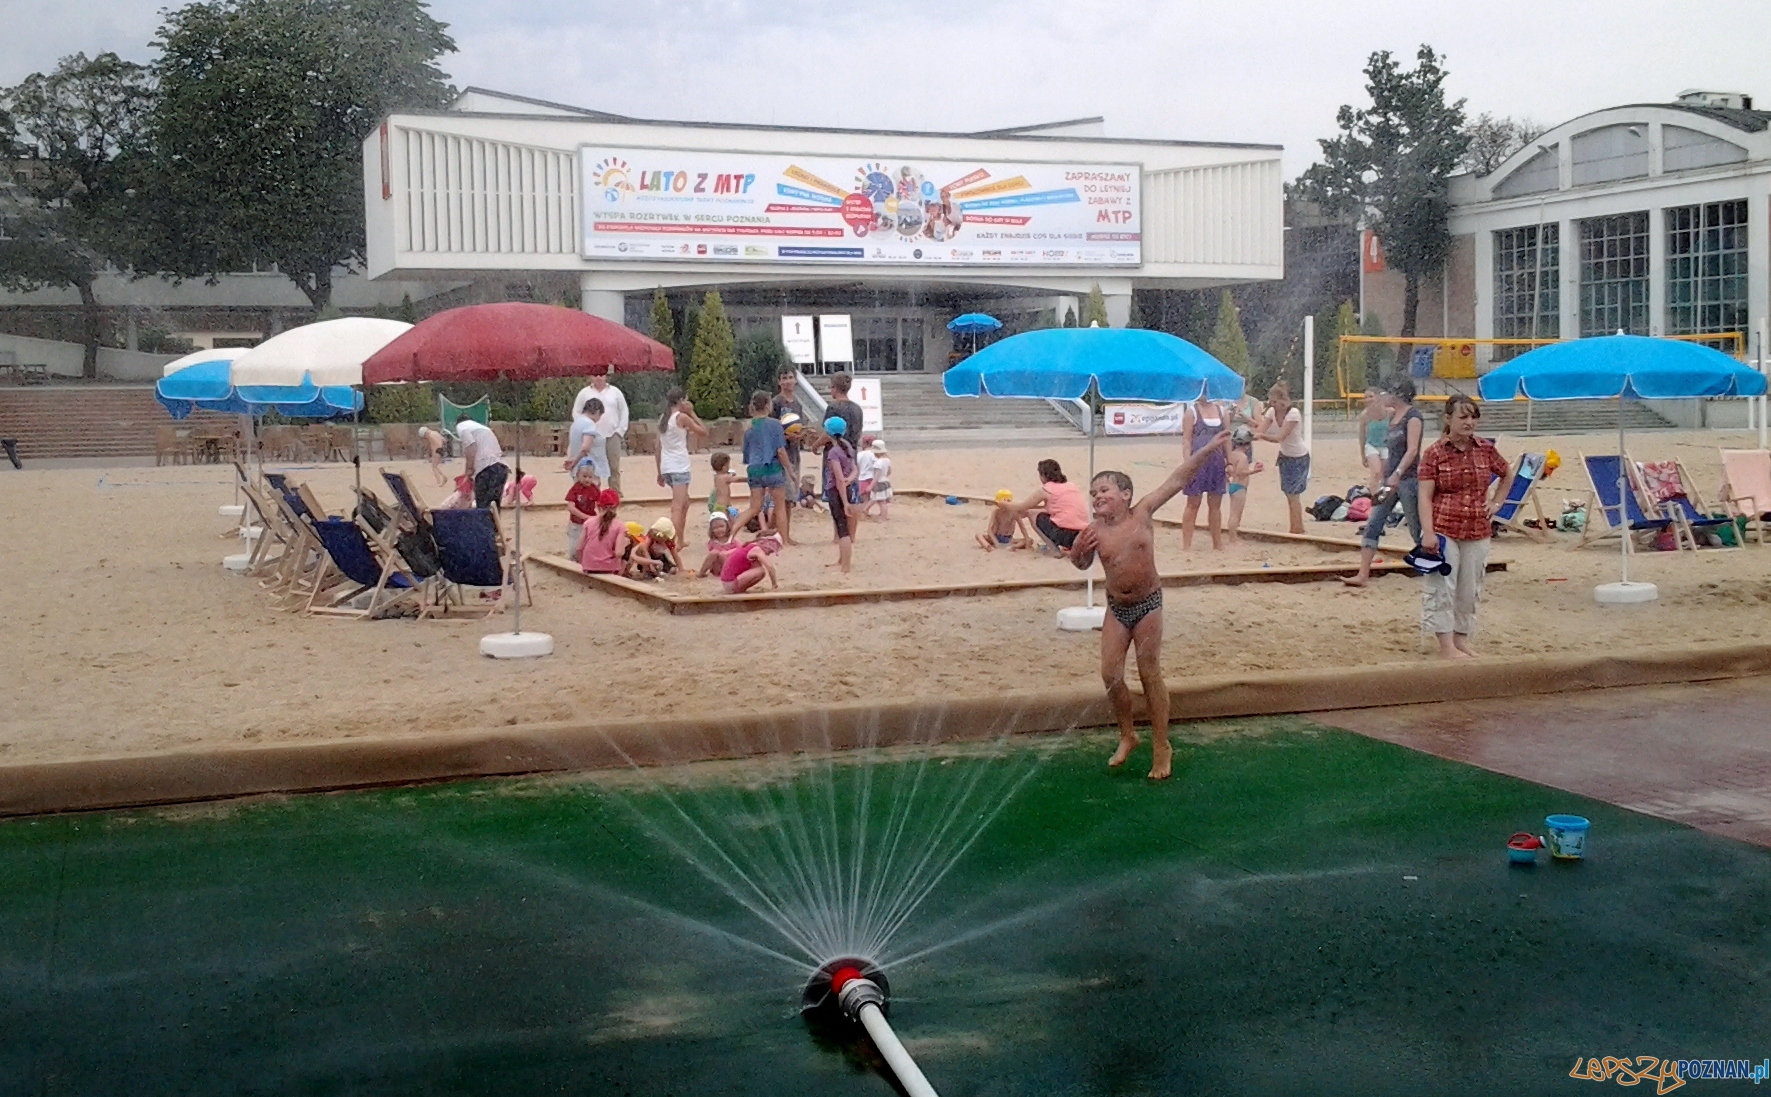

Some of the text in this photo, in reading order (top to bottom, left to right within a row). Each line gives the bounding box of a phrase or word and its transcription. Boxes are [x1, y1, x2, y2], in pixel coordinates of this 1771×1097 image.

[640, 170, 756, 195] LATO Z MTP
[1065, 172, 1131, 182] ZAPRASZAMY
[1084, 185, 1131, 193] DO LETNIEJ
[1088, 197, 1123, 205] ZABAWY
[593, 211, 771, 223] WYSPA ROZRYWEK W SERCU POZNANIA
[1096, 209, 1133, 224] MTP
